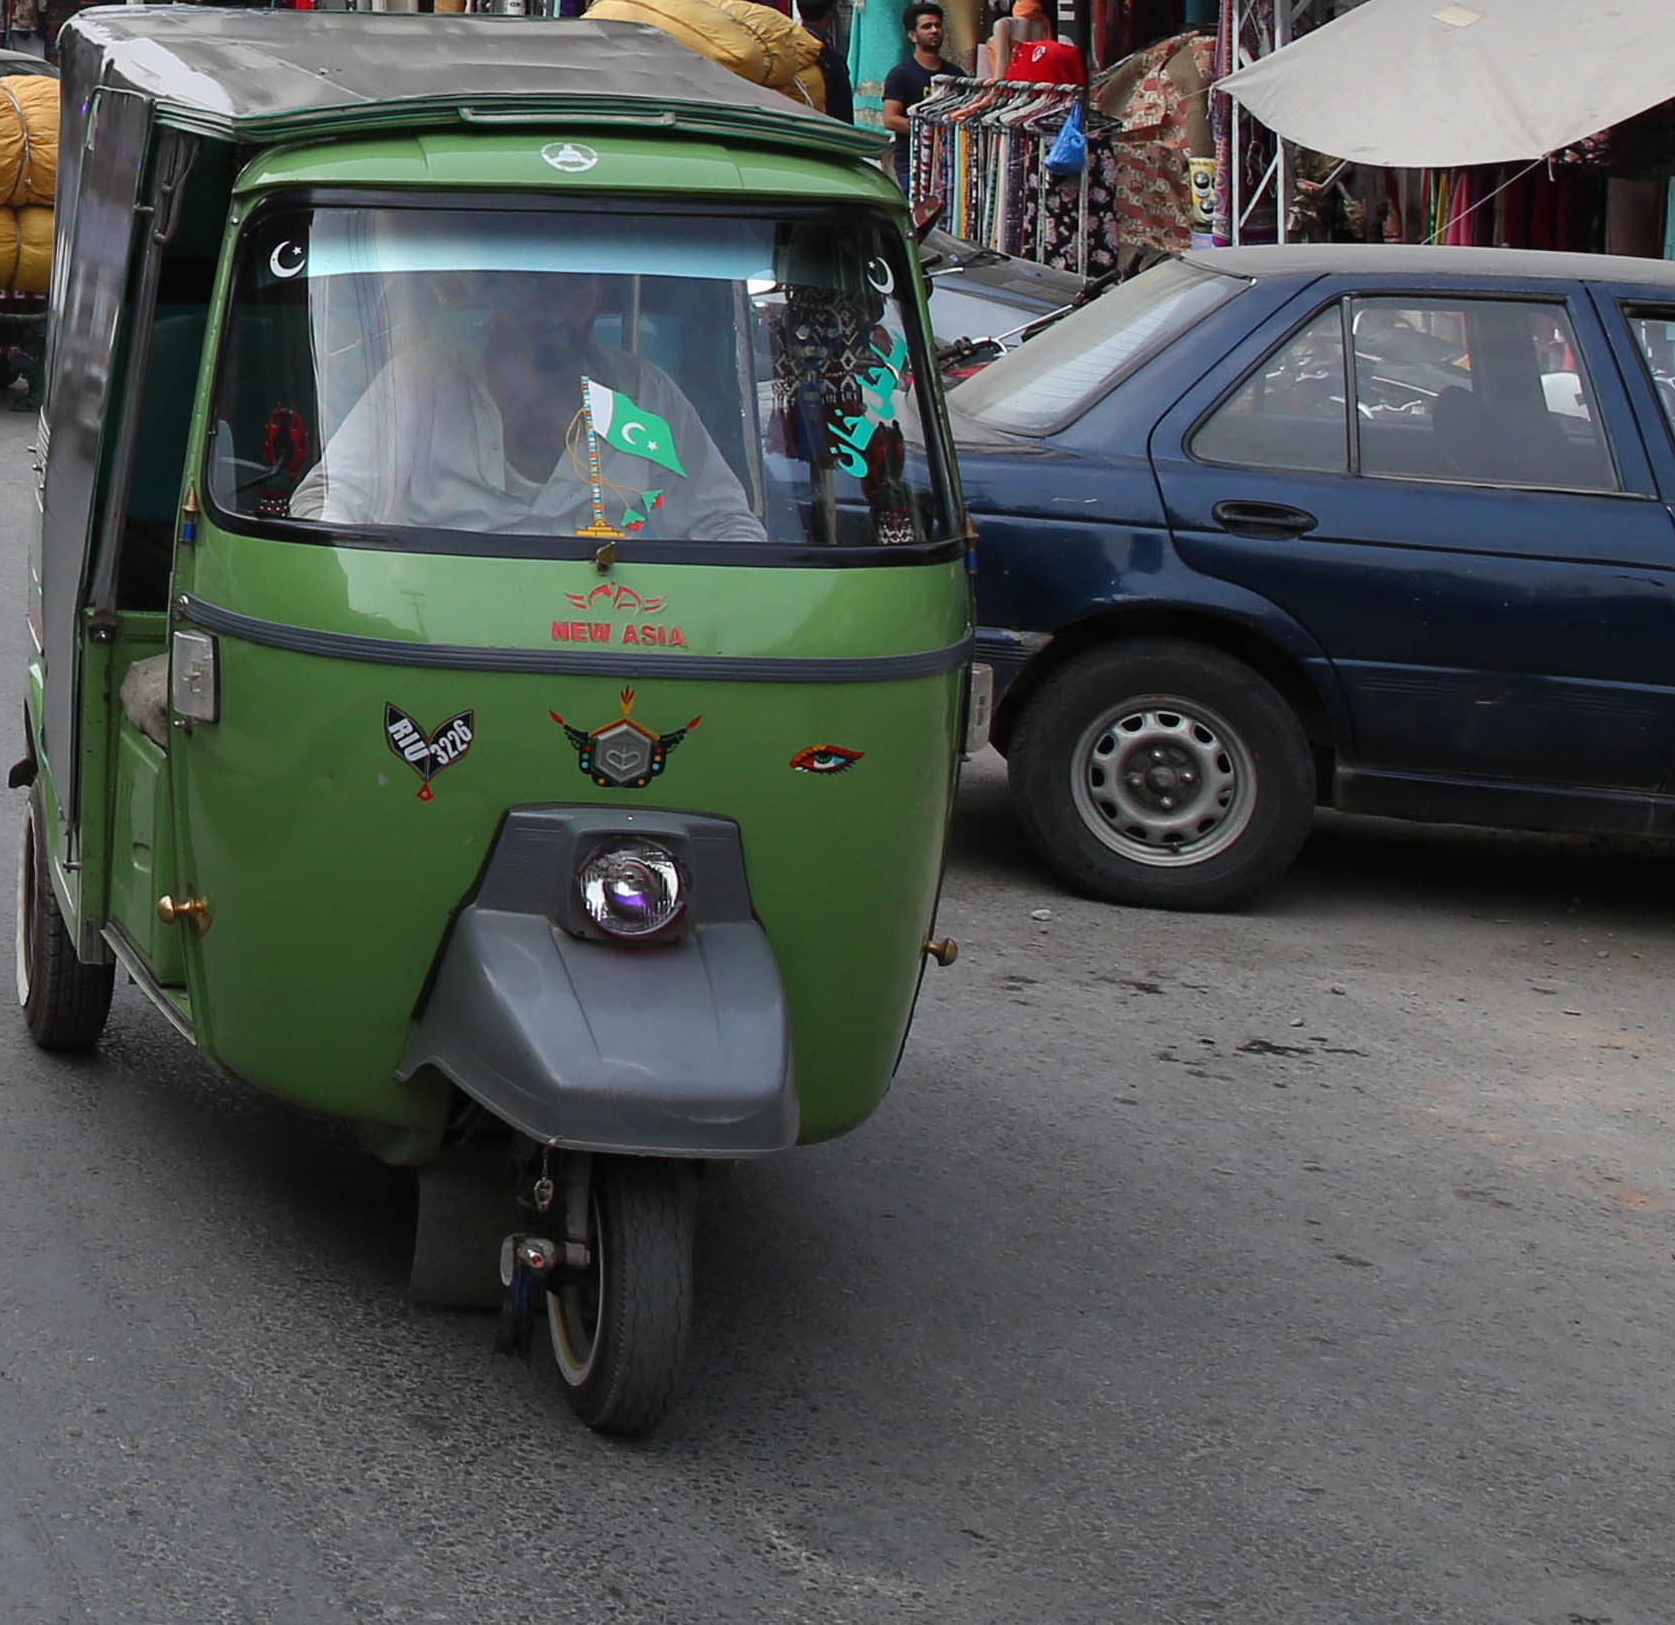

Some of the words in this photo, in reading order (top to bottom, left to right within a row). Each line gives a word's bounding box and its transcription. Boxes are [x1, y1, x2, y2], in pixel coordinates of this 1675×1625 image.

[826, 407, 877, 479] خان
[551, 621, 612, 643] NEW
[622, 624, 689, 647] ASIA
[388, 717, 431, 763] RIU
[429, 717, 473, 766] 3226
